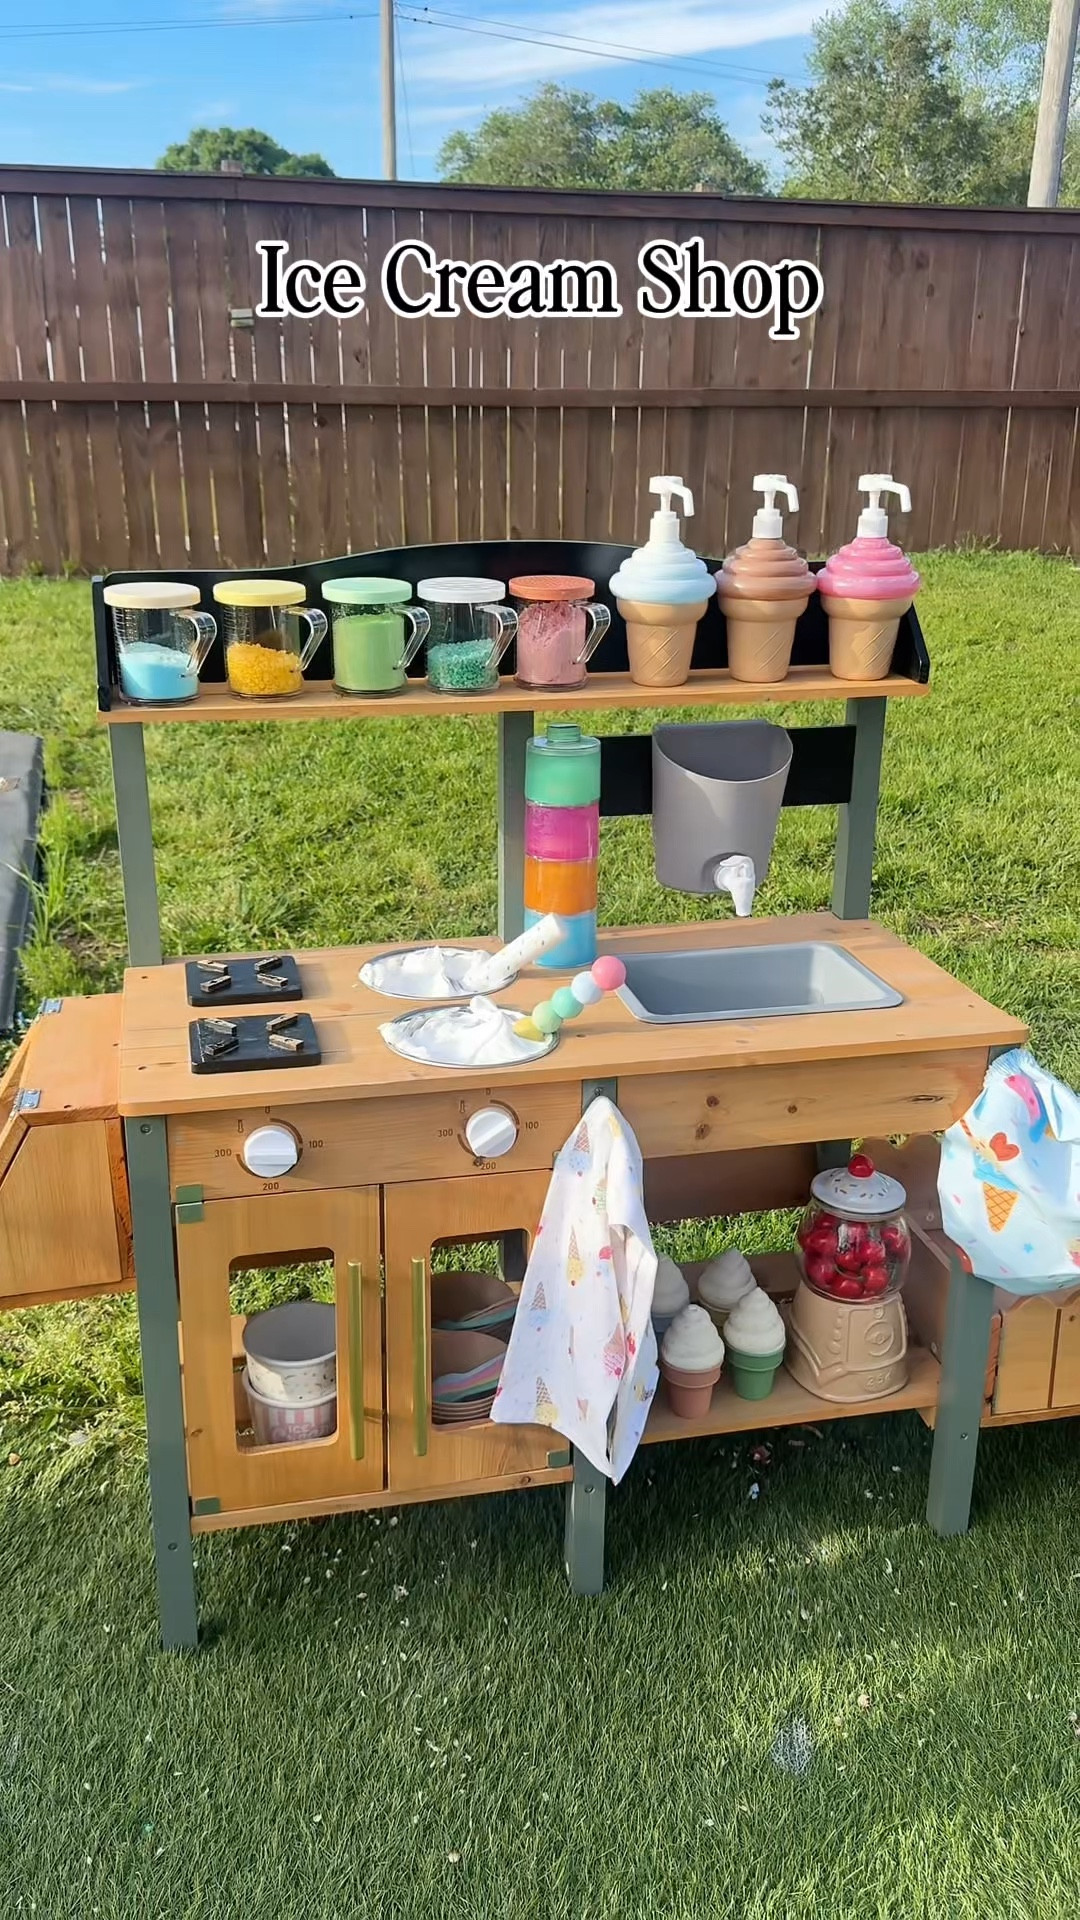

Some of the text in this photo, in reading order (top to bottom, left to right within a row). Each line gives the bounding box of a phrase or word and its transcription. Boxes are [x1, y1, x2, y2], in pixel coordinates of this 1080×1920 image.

[525, 1121, 539, 1129] 100
[437, 1128, 453, 1137] 300
[308, 1140, 323, 1149] 100
[214, 1148, 232, 1157] 300
[481, 1161, 496, 1170] 200
[262, 1182, 279, 1191] 200
